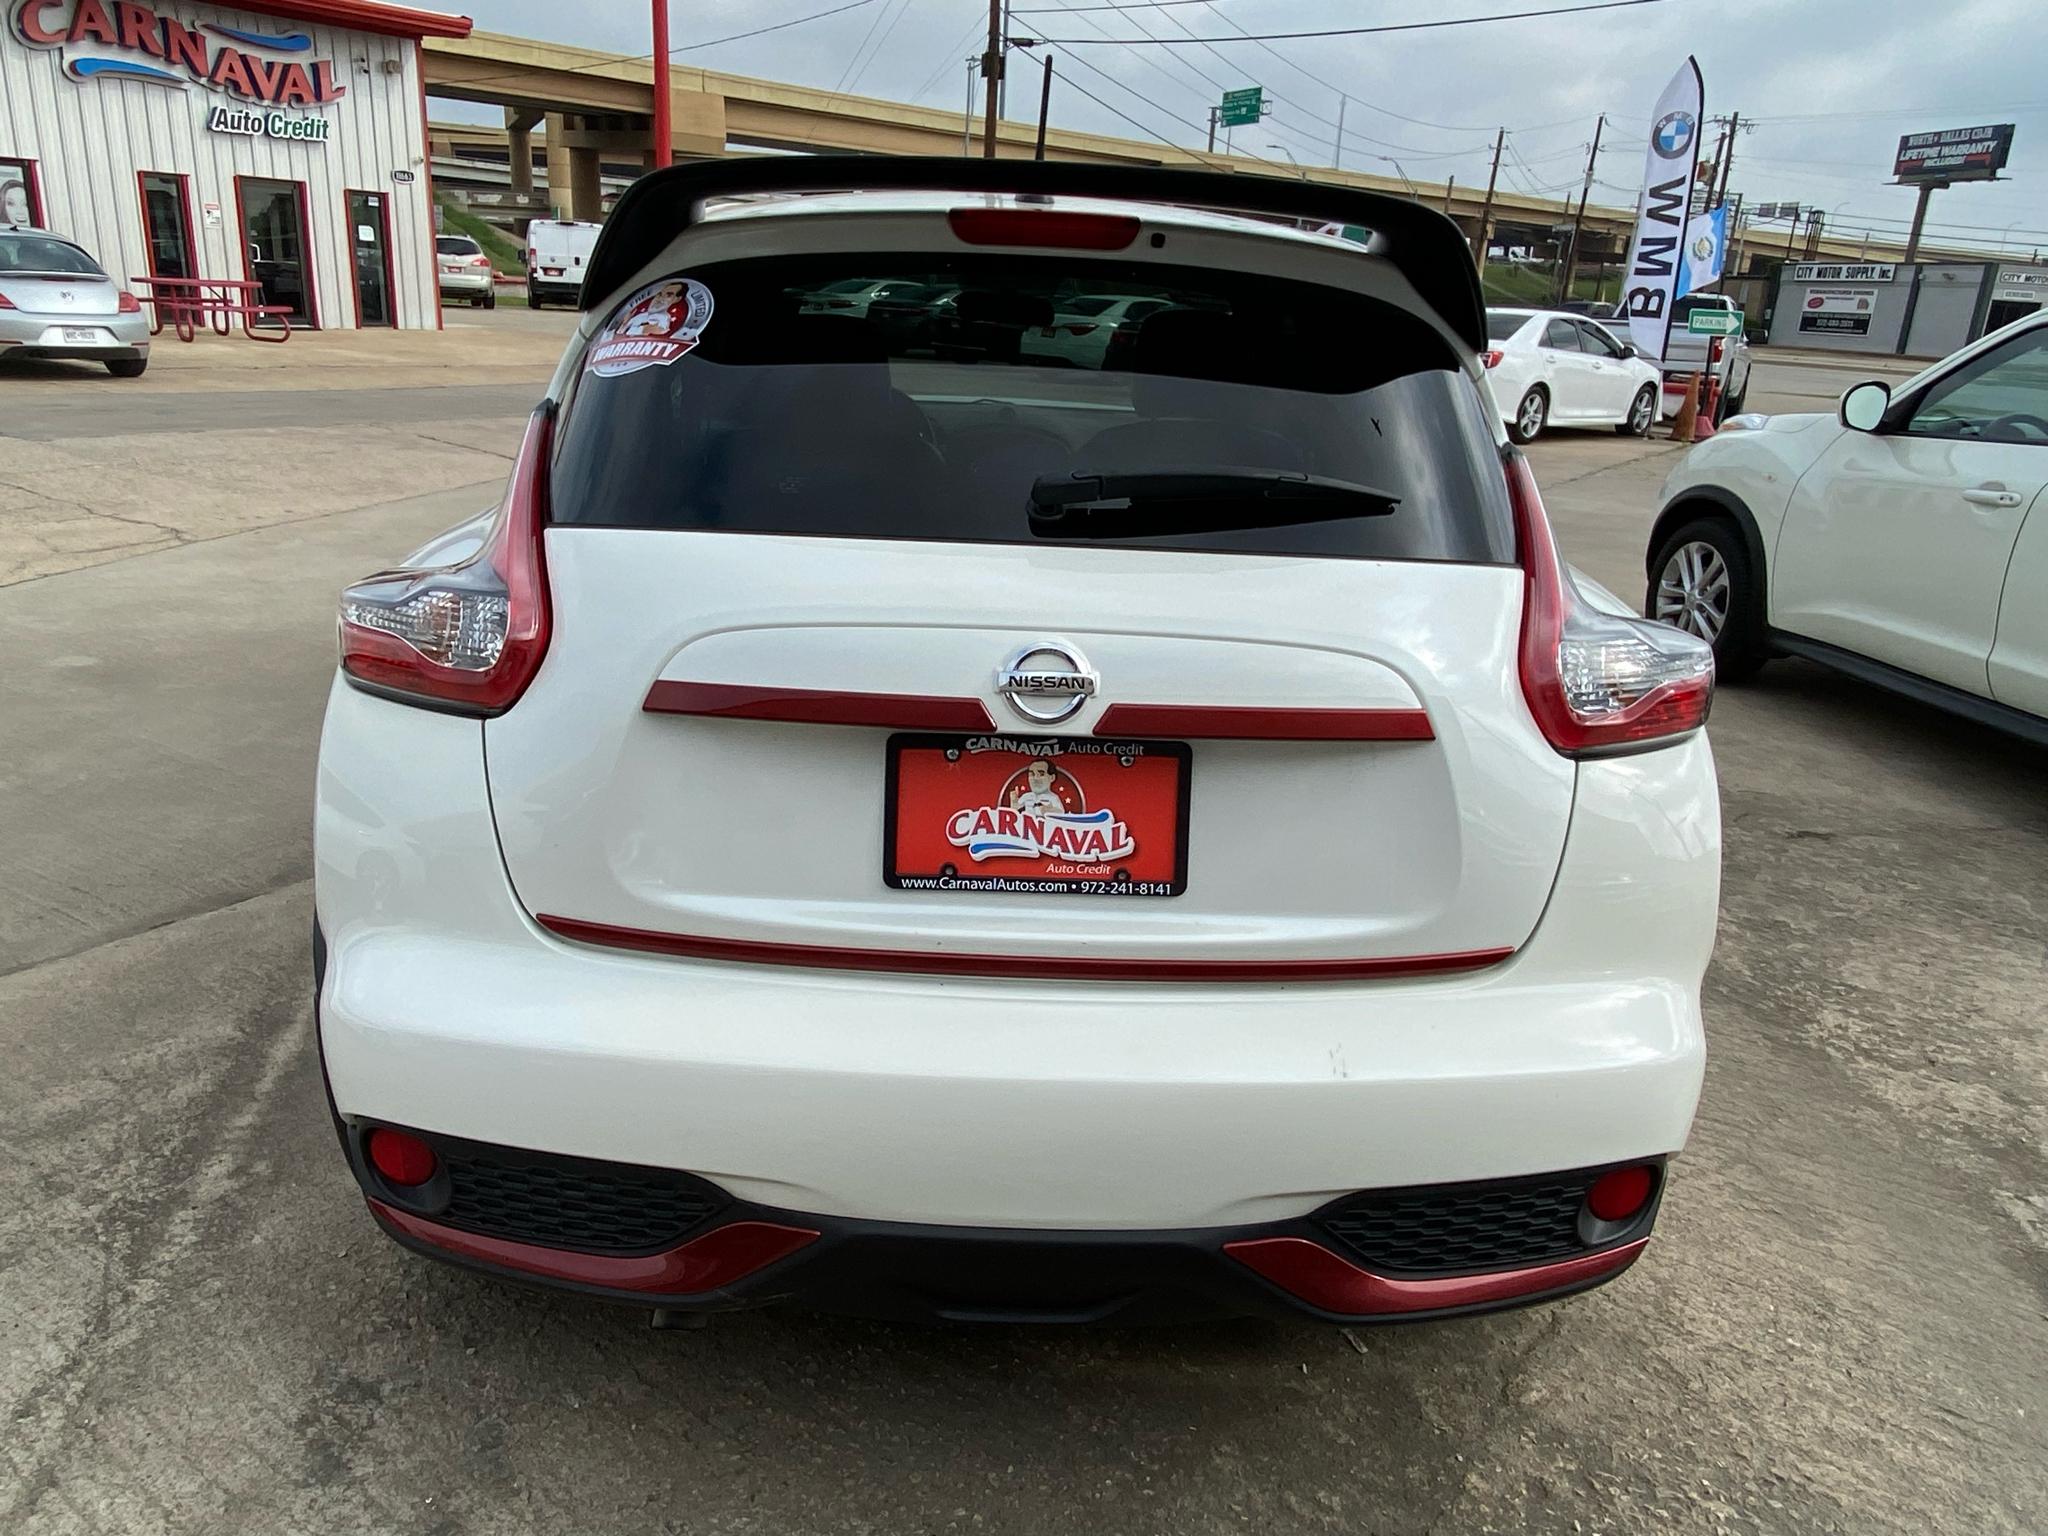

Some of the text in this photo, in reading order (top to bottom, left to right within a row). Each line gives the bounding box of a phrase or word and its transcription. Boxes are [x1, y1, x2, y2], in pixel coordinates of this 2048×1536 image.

[18, 0, 346, 103] CARNAVAL
[214, 107, 329, 141] Auto Credit
[1900, 141, 1997, 160] LIFETIME WARRANTY
[1796, 266, 1814, 279] CITY
[1816, 266, 1843, 279] MOTOR
[2002, 273, 2022, 281] CITY
[691, 289, 706, 317] LIMITED
[1694, 317, 1727, 329] PARKING
[592, 341, 679, 364] WARRANTY
[1008, 674, 1086, 690] NISSAN
[965, 736, 1145, 757] CARNAVAL Auto Credit
[946, 807, 1133, 858] CARNAVAL
[1046, 863, 1112, 875] Auto Credit
[901, 876, 1172, 895] www.CarnavalAutos.com 972-241-8141
